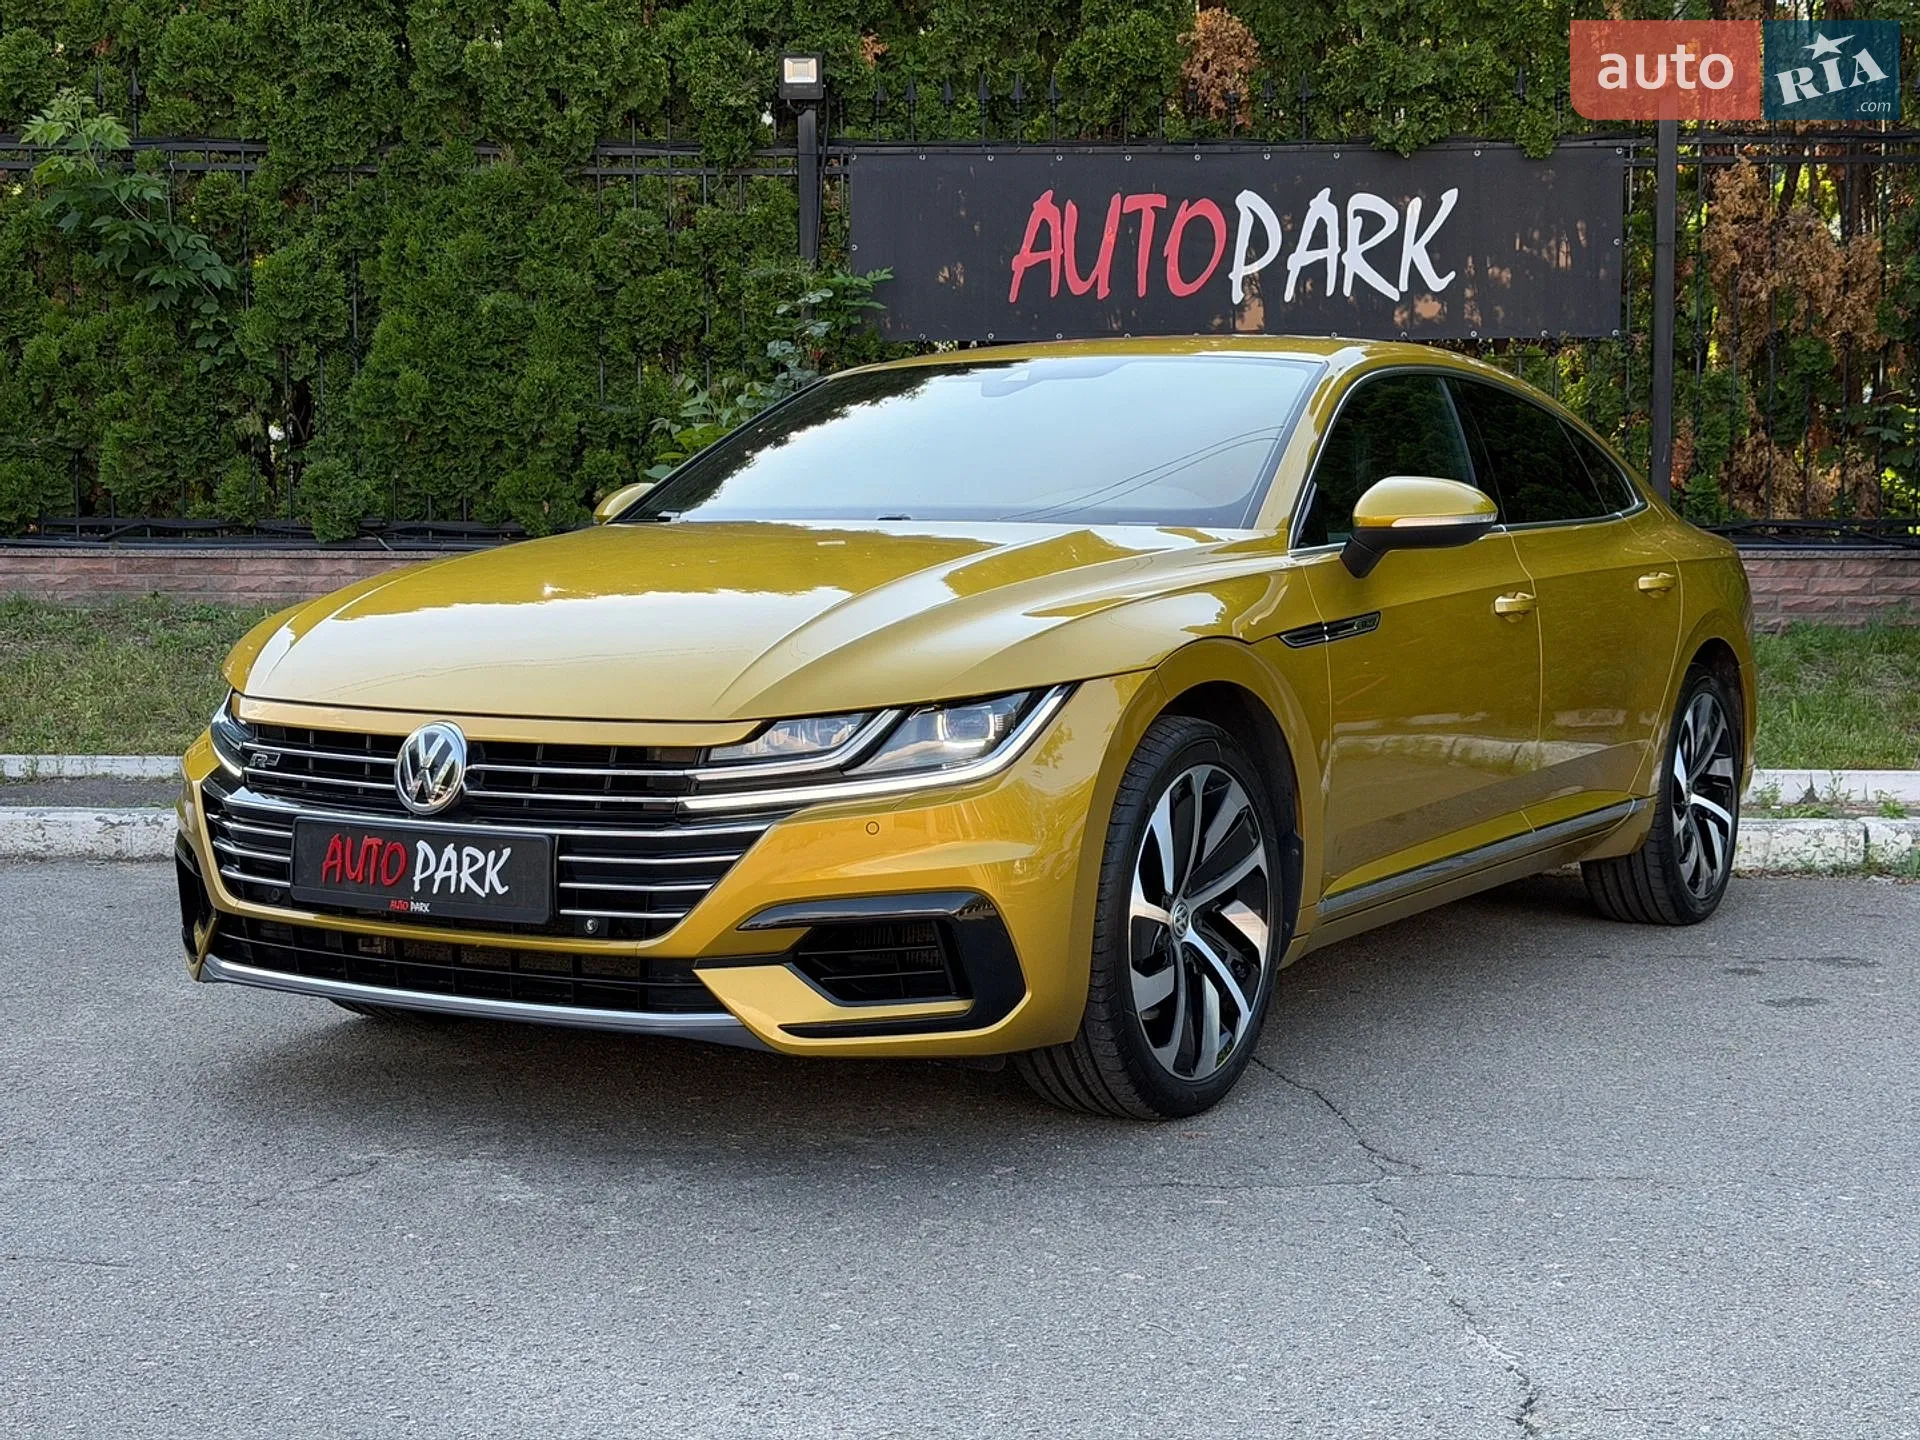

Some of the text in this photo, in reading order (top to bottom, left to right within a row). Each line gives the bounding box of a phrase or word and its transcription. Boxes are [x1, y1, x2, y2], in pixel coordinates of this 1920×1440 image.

[322, 833, 512, 898] AUTO PARK
[389, 899, 431, 912] AUTO PARK
